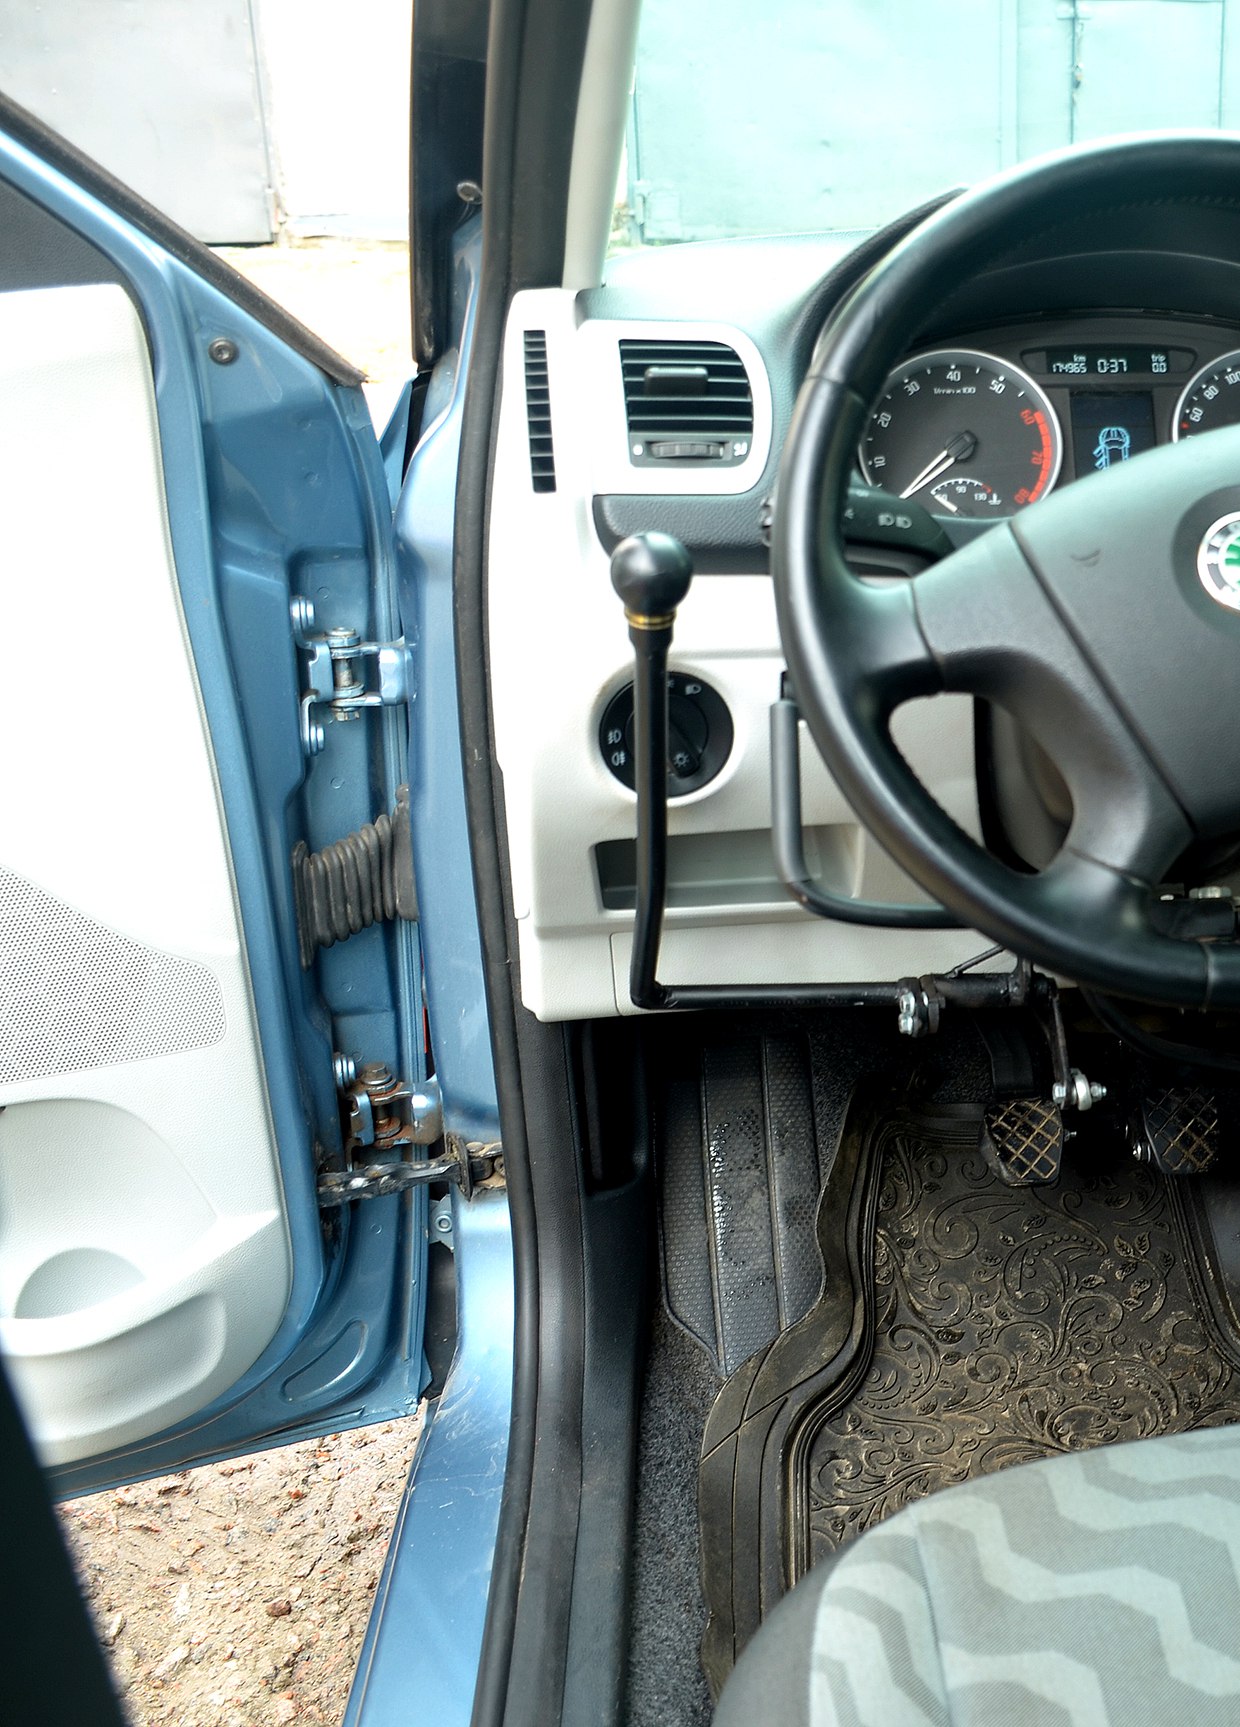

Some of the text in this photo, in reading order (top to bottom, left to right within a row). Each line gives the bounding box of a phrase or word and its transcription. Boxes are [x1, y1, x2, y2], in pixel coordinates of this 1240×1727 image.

[1073, 354, 1087, 362] km
[1151, 354, 1166, 363] trip
[1052, 362, 1087, 373] 174965
[1097, 359, 1127, 373] 0:37
[946, 371, 961, 382] 40
[904, 381, 920, 396] 30
[989, 379, 1005, 394] 50
[1203, 385, 1219, 400] 80
[877, 412, 892, 428] 20
[1020, 408, 1036, 426] 60
[1189, 407, 1204, 422] 60
[873, 456, 887, 468] 10
[1031, 451, 1043, 465] 70
[1014, 487, 1031, 504] 80
